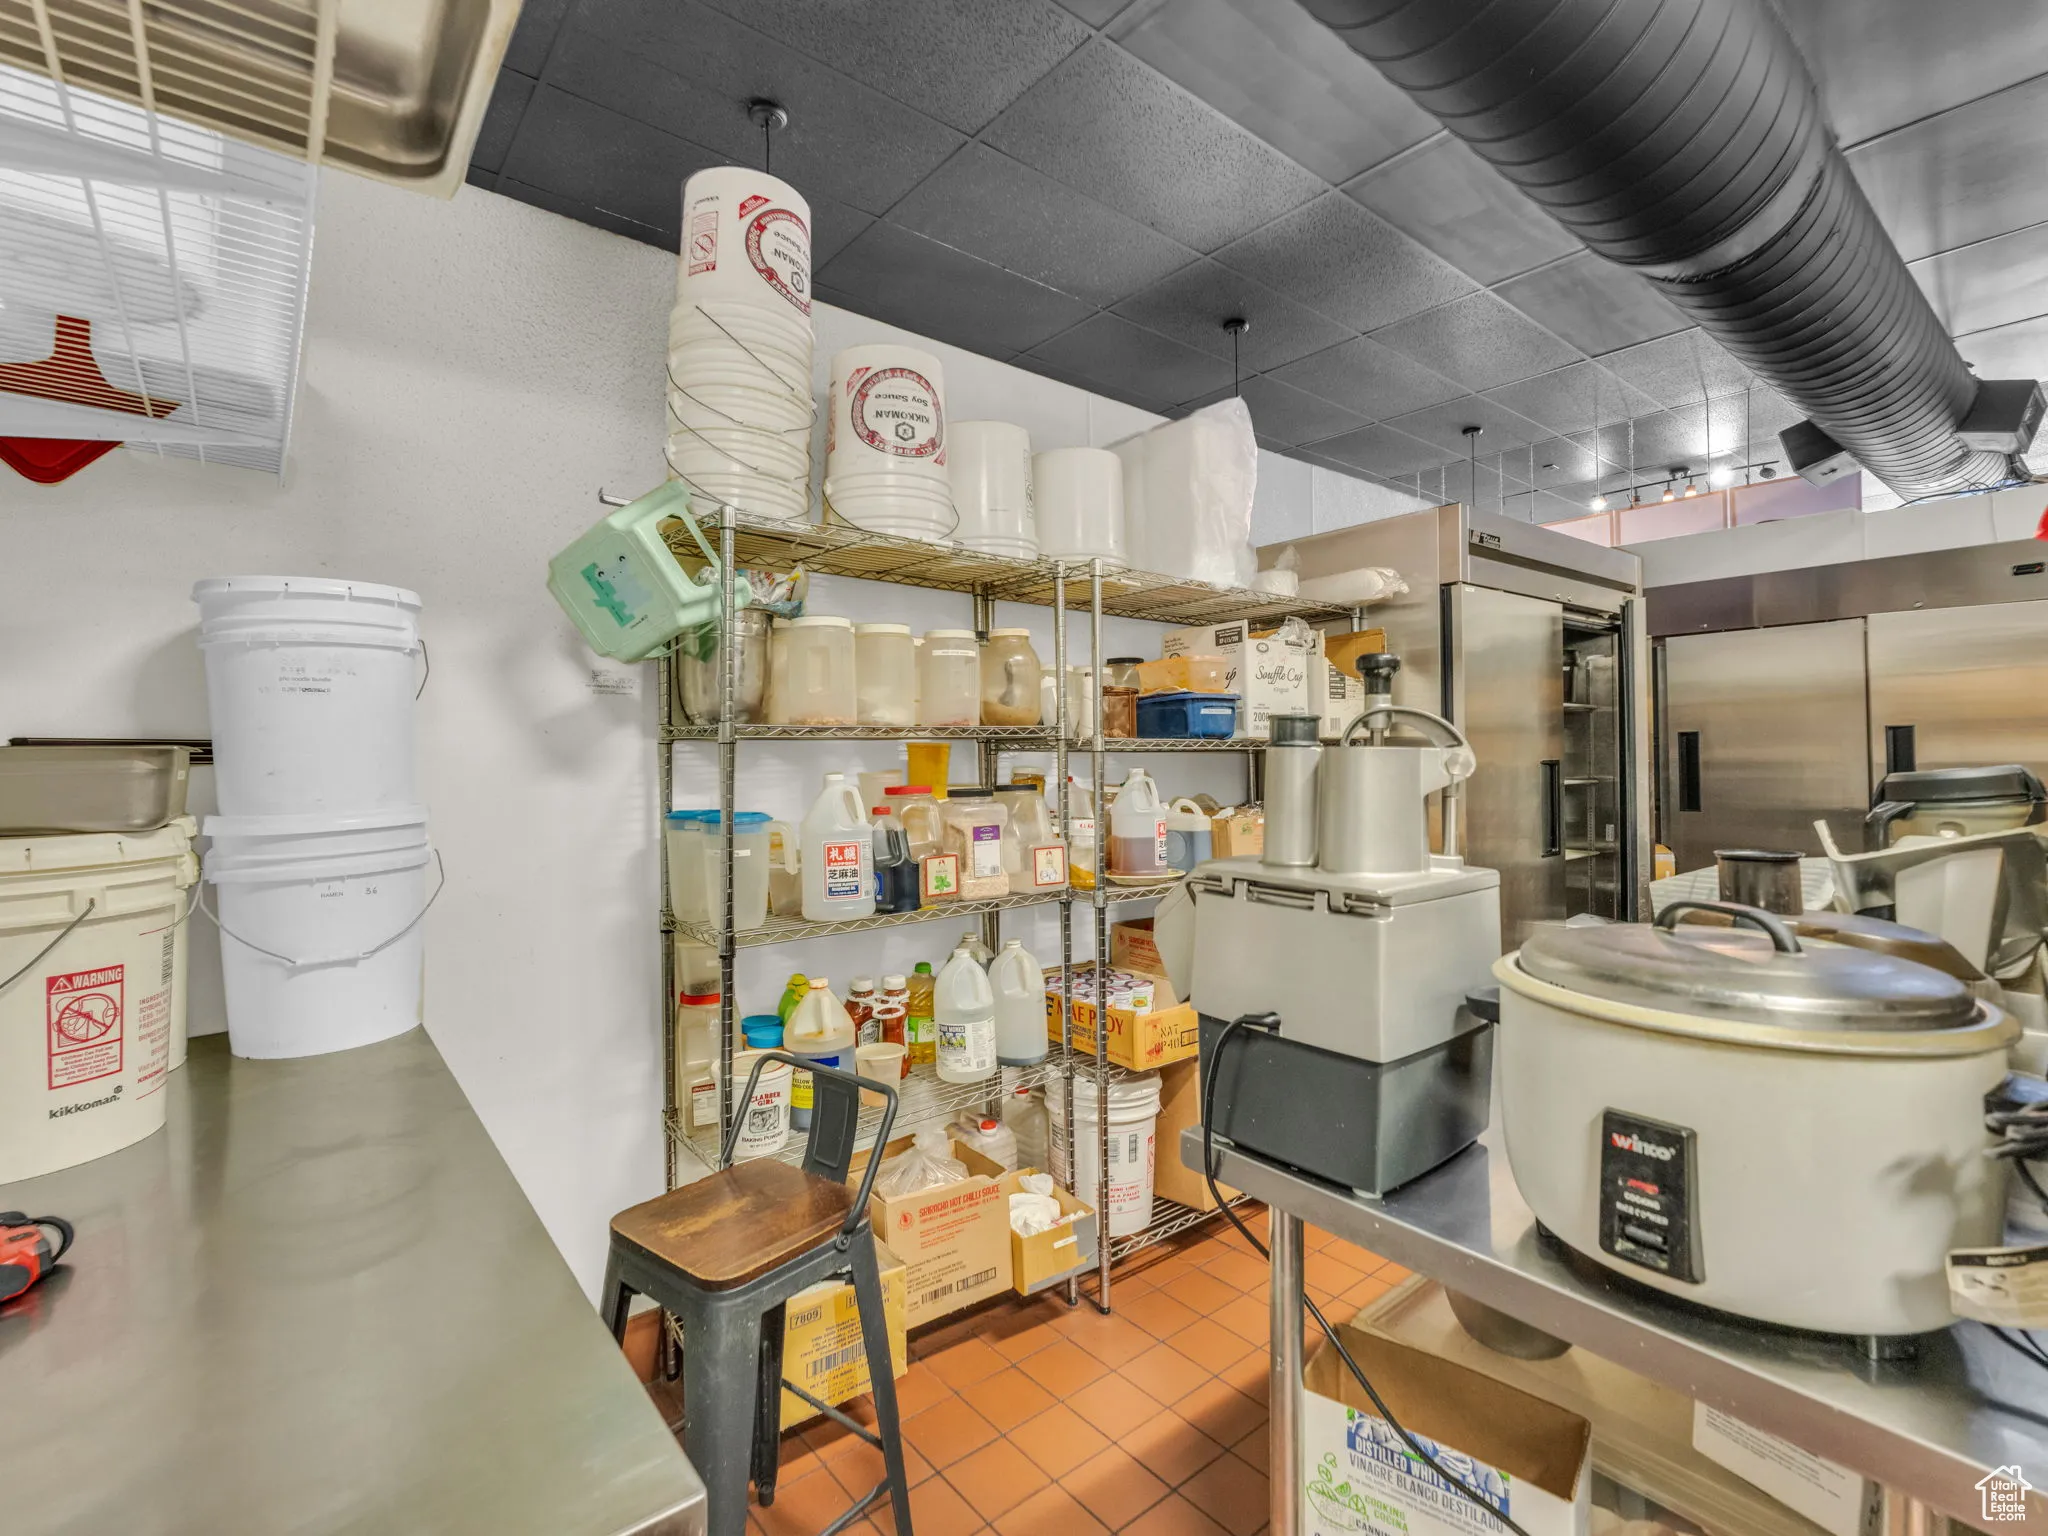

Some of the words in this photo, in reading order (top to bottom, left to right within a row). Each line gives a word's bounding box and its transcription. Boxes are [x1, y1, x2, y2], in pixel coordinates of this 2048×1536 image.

[875, 393, 908, 403] Sauce
[912, 396, 928, 407] Soy
[875, 410, 930, 424] KIKKOMAN
[72, 967, 123, 989] WARNING
[1611, 1132, 1672, 1162] winco
[1355, 1439, 1407, 1472] DISTILLED
[1410, 1460, 1445, 1490] WHITE
[1350, 1452, 1393, 1482] VINAGRE
[1397, 1473, 1438, 1502] BLANCO
